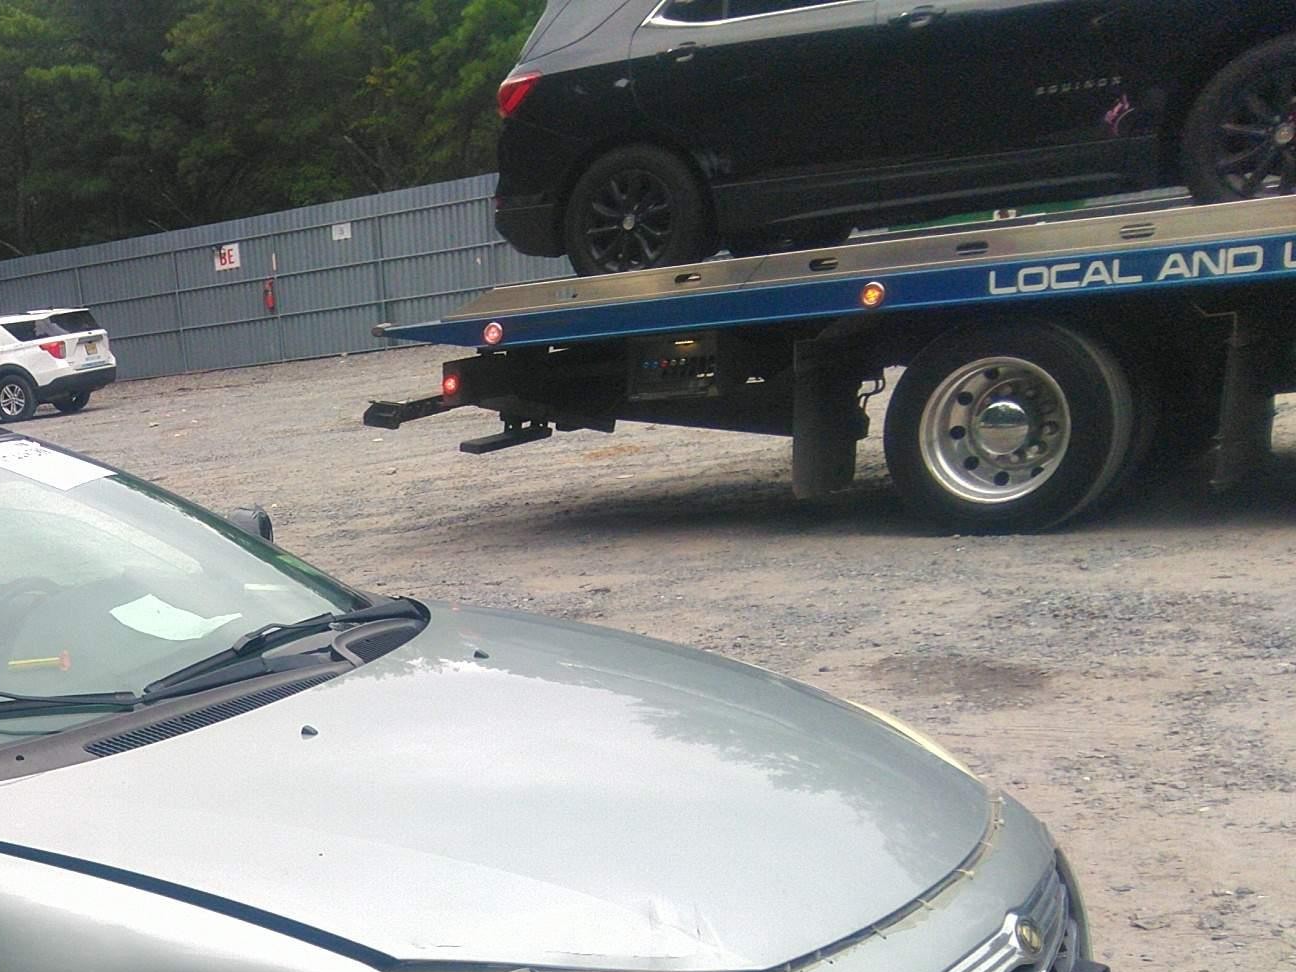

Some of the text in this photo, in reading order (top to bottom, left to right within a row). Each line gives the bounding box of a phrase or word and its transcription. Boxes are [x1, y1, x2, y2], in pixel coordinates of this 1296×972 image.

[219, 248, 235, 266] BE
[988, 258, 1143, 295] LOCAL
[1156, 244, 1264, 281] AND
